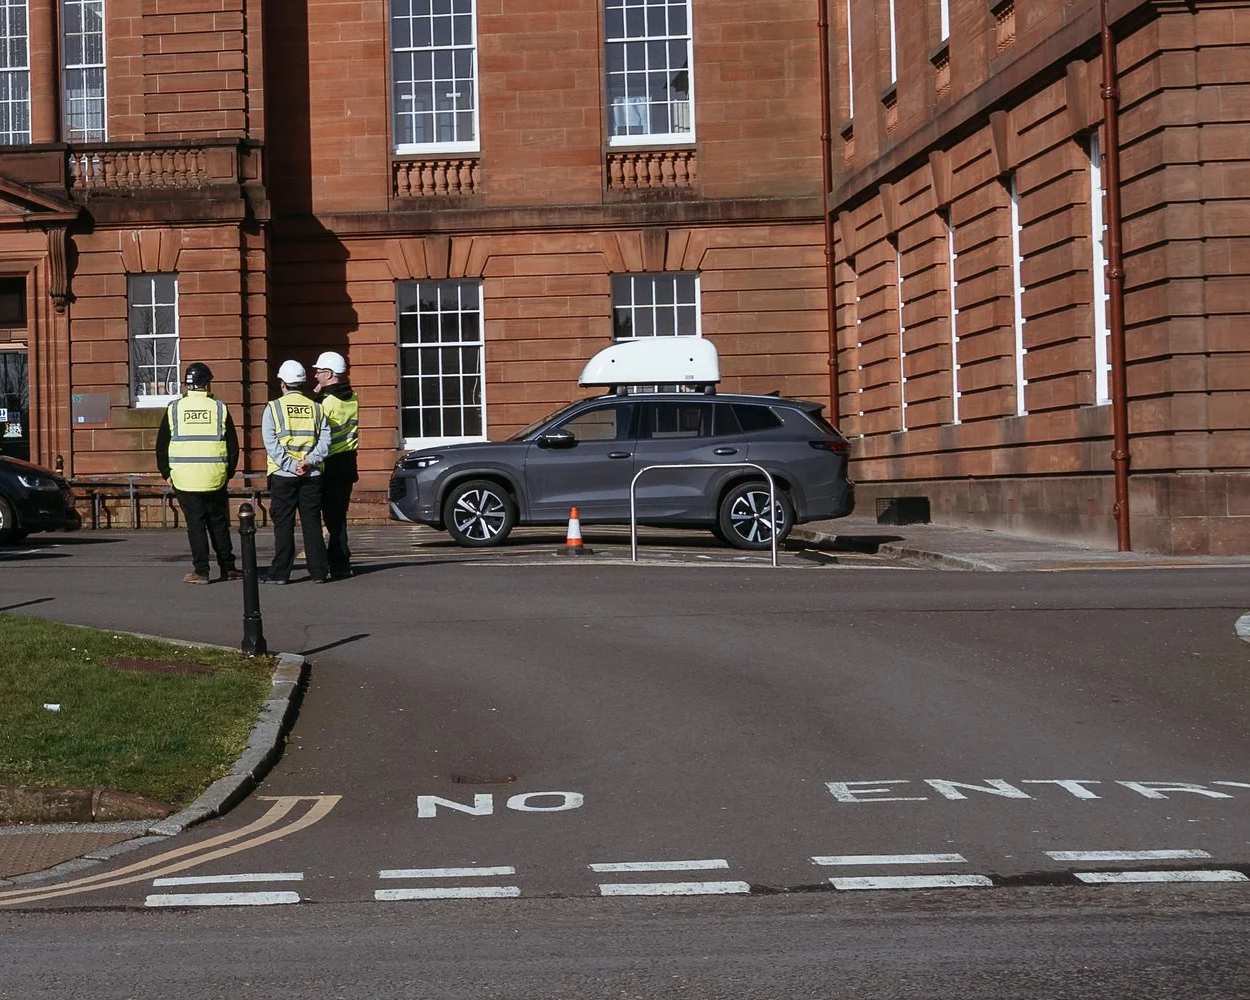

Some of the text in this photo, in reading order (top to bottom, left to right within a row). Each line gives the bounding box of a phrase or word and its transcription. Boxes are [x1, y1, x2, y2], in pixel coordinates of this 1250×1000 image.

[287, 405, 310, 414] parc
[184, 411, 208, 422] parc
[416, 778, 1250, 818] NO ENTR
